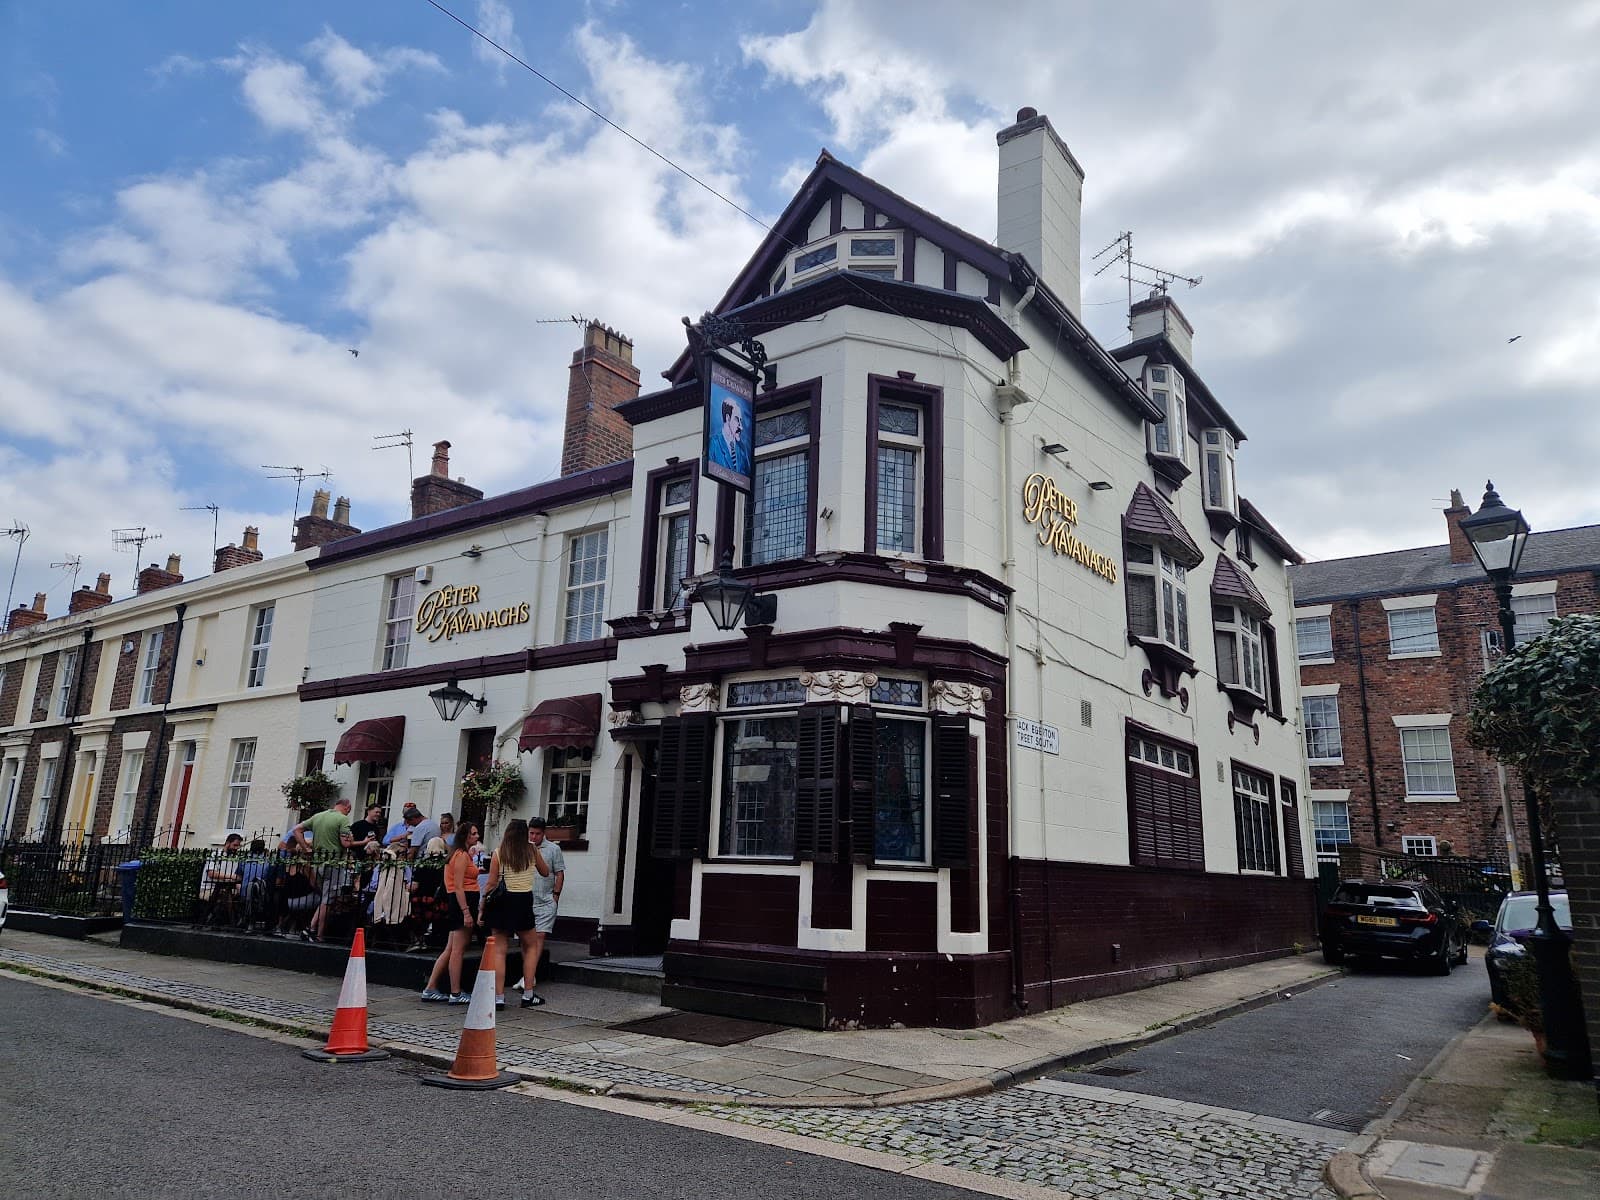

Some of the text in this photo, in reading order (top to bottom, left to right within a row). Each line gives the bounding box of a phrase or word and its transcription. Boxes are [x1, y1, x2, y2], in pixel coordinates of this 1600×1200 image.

[1024, 472, 1078, 526] PETER
[416, 584, 479, 633] PETER
[1016, 720, 1029, 732] ACK
[1016, 731, 1033, 744] TREET
